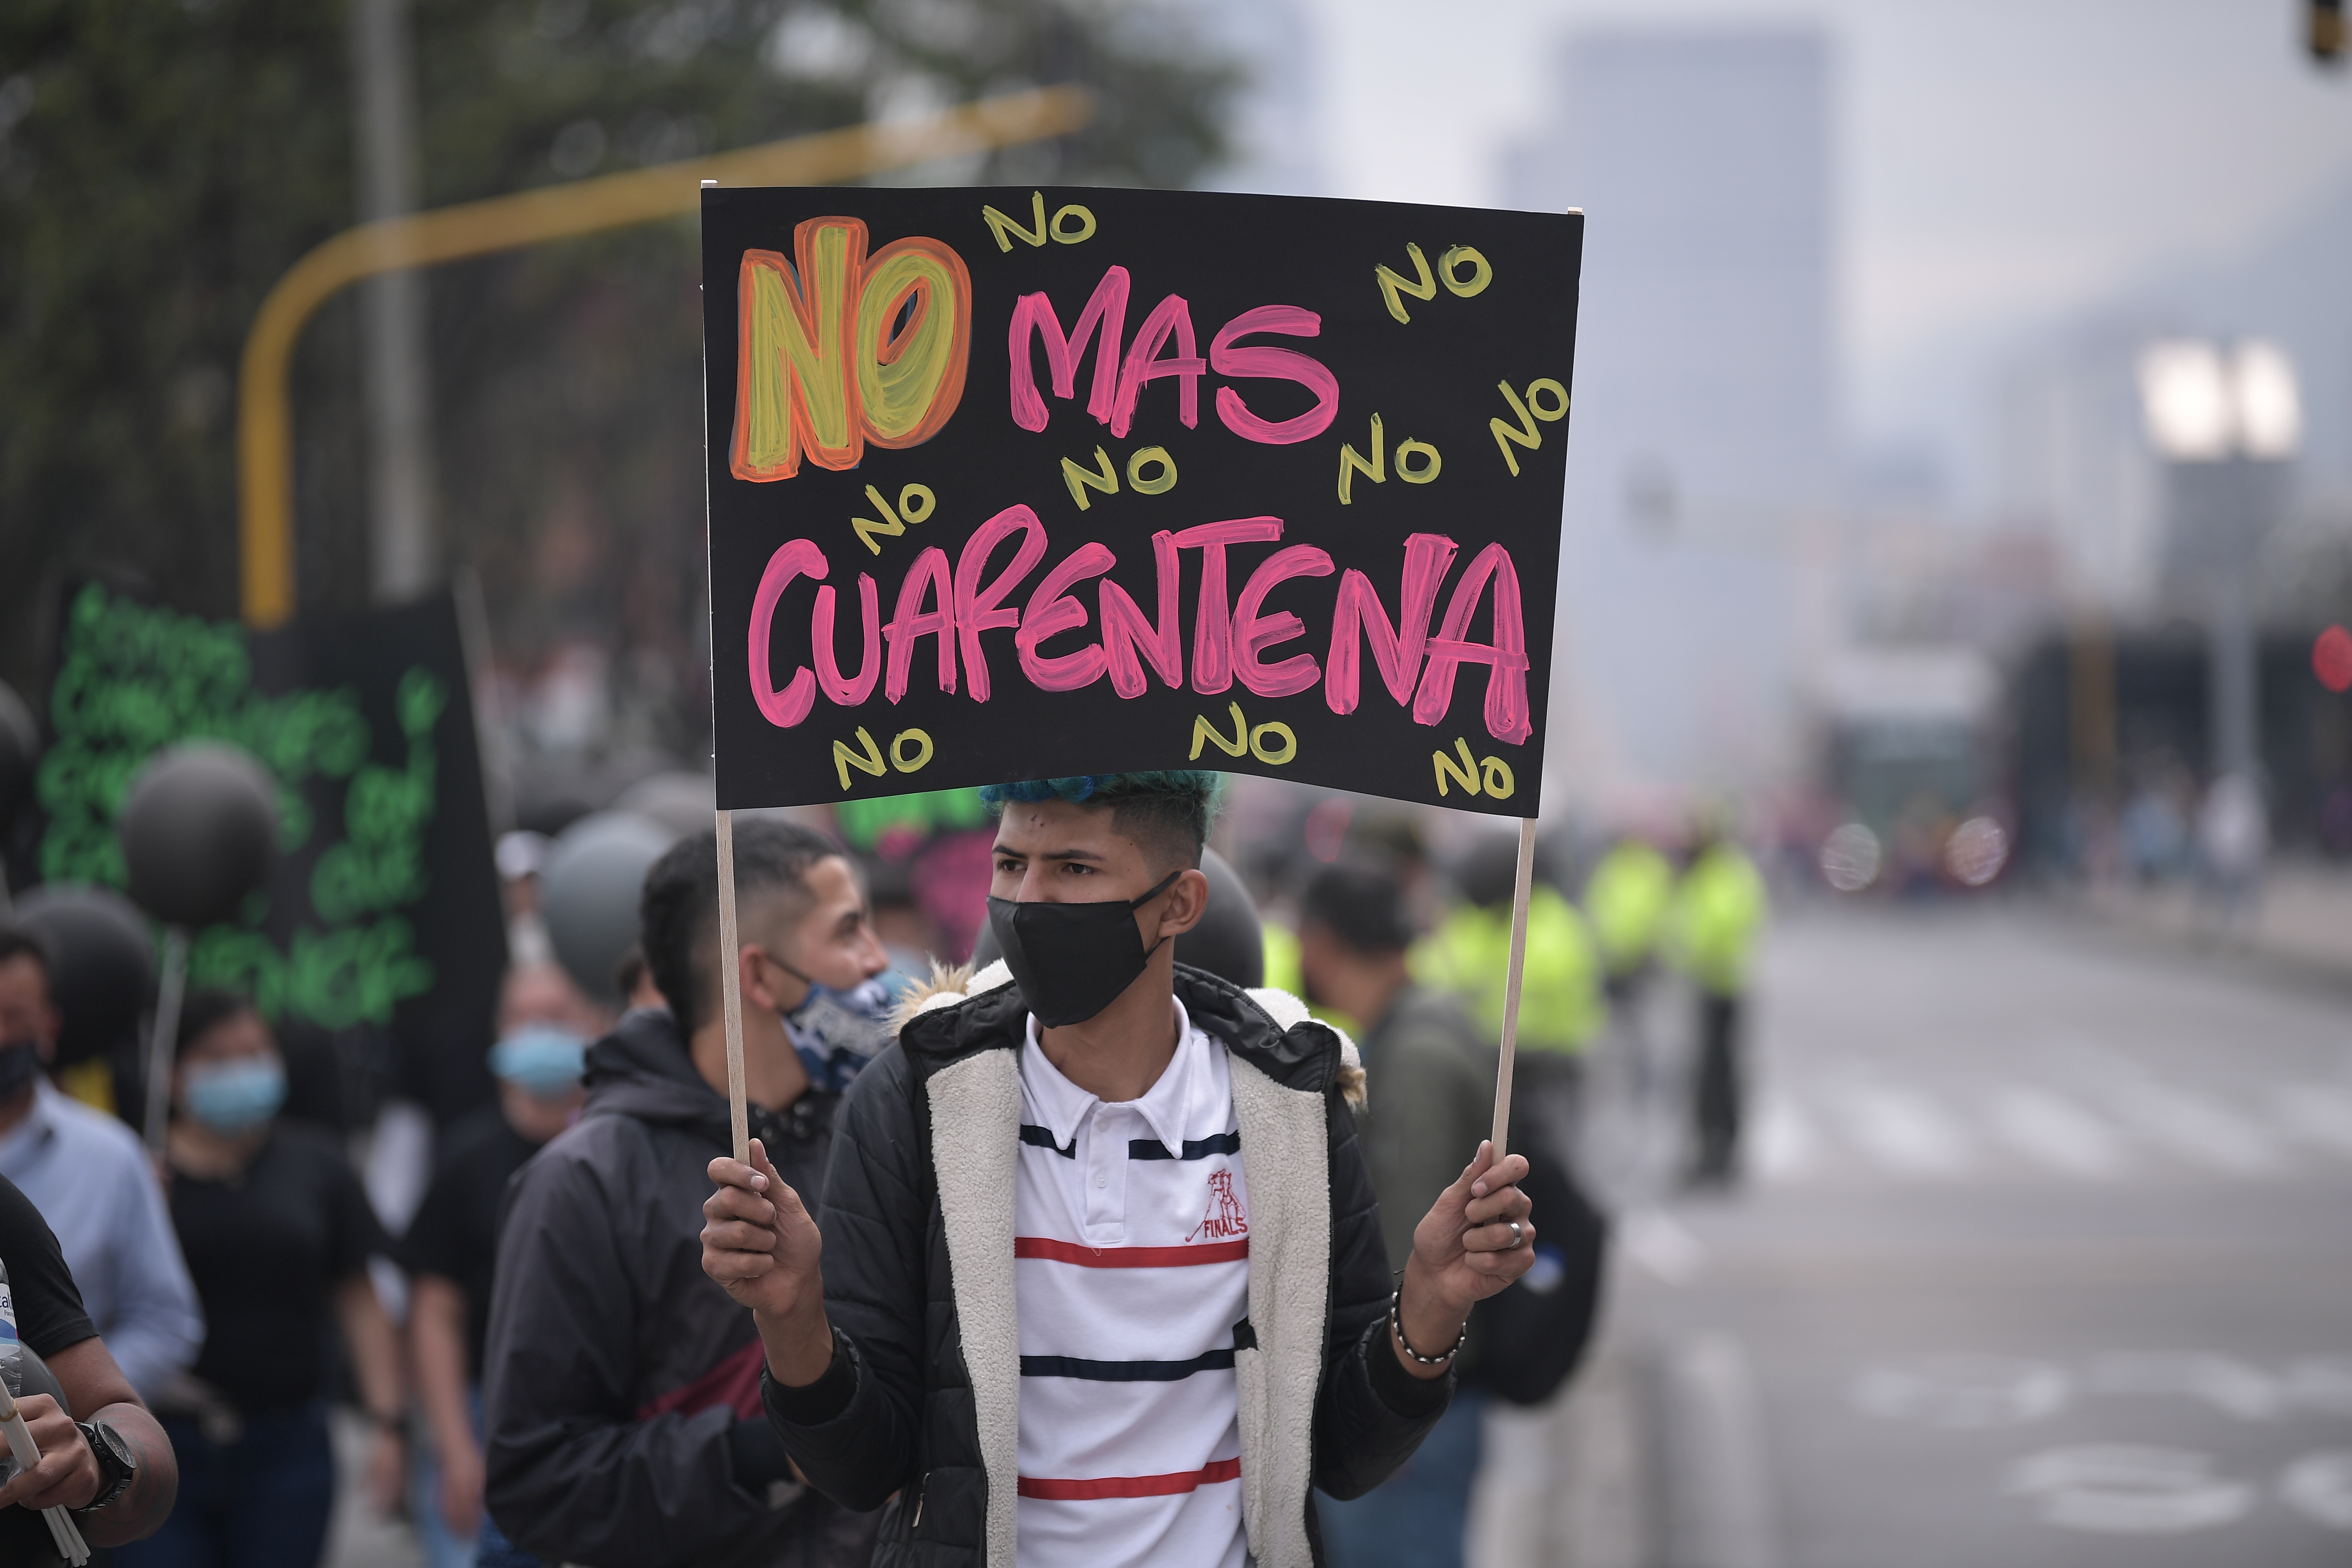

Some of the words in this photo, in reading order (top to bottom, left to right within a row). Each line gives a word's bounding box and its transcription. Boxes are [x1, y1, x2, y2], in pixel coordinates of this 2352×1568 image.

[730, 215, 972, 483] NO
[1008, 264, 1339, 445] MAS
[748, 504, 1533, 747] CUARENTENA
[1204, 1217, 1248, 1238] FINALS
